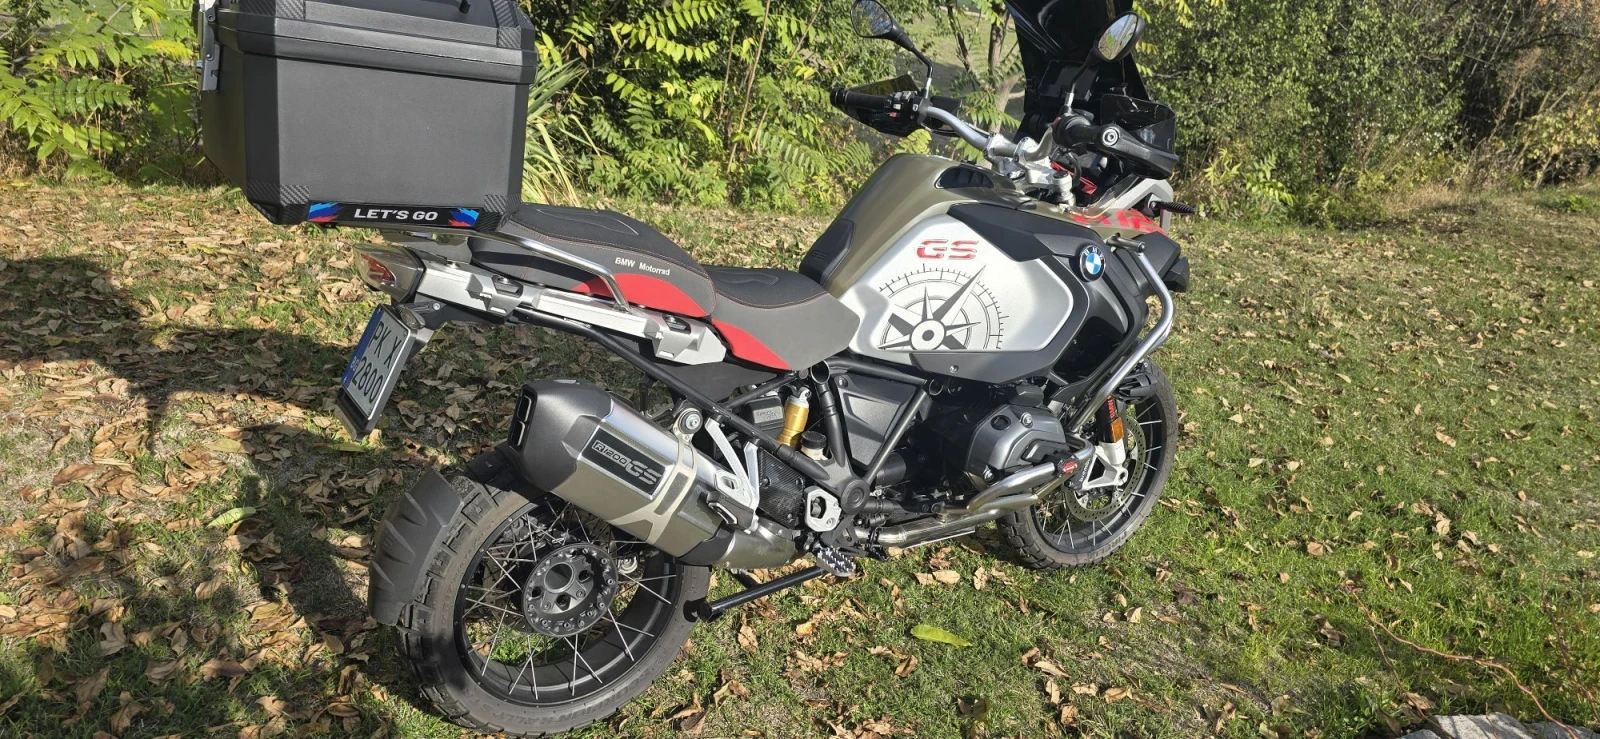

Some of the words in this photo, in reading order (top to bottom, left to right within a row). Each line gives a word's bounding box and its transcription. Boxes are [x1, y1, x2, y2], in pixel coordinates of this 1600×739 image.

[354, 208, 410, 220] LET'S
[412, 210, 438, 221] GO
[614, 256, 636, 268] BMW
[638, 261, 671, 276] Motorrad
[916, 239, 979, 260] GS
[368, 320, 392, 359] PK
[383, 336, 402, 370] X
[351, 355, 384, 404] 2800
[592, 440, 631, 468] R1200
[625, 460, 662, 485] GS
